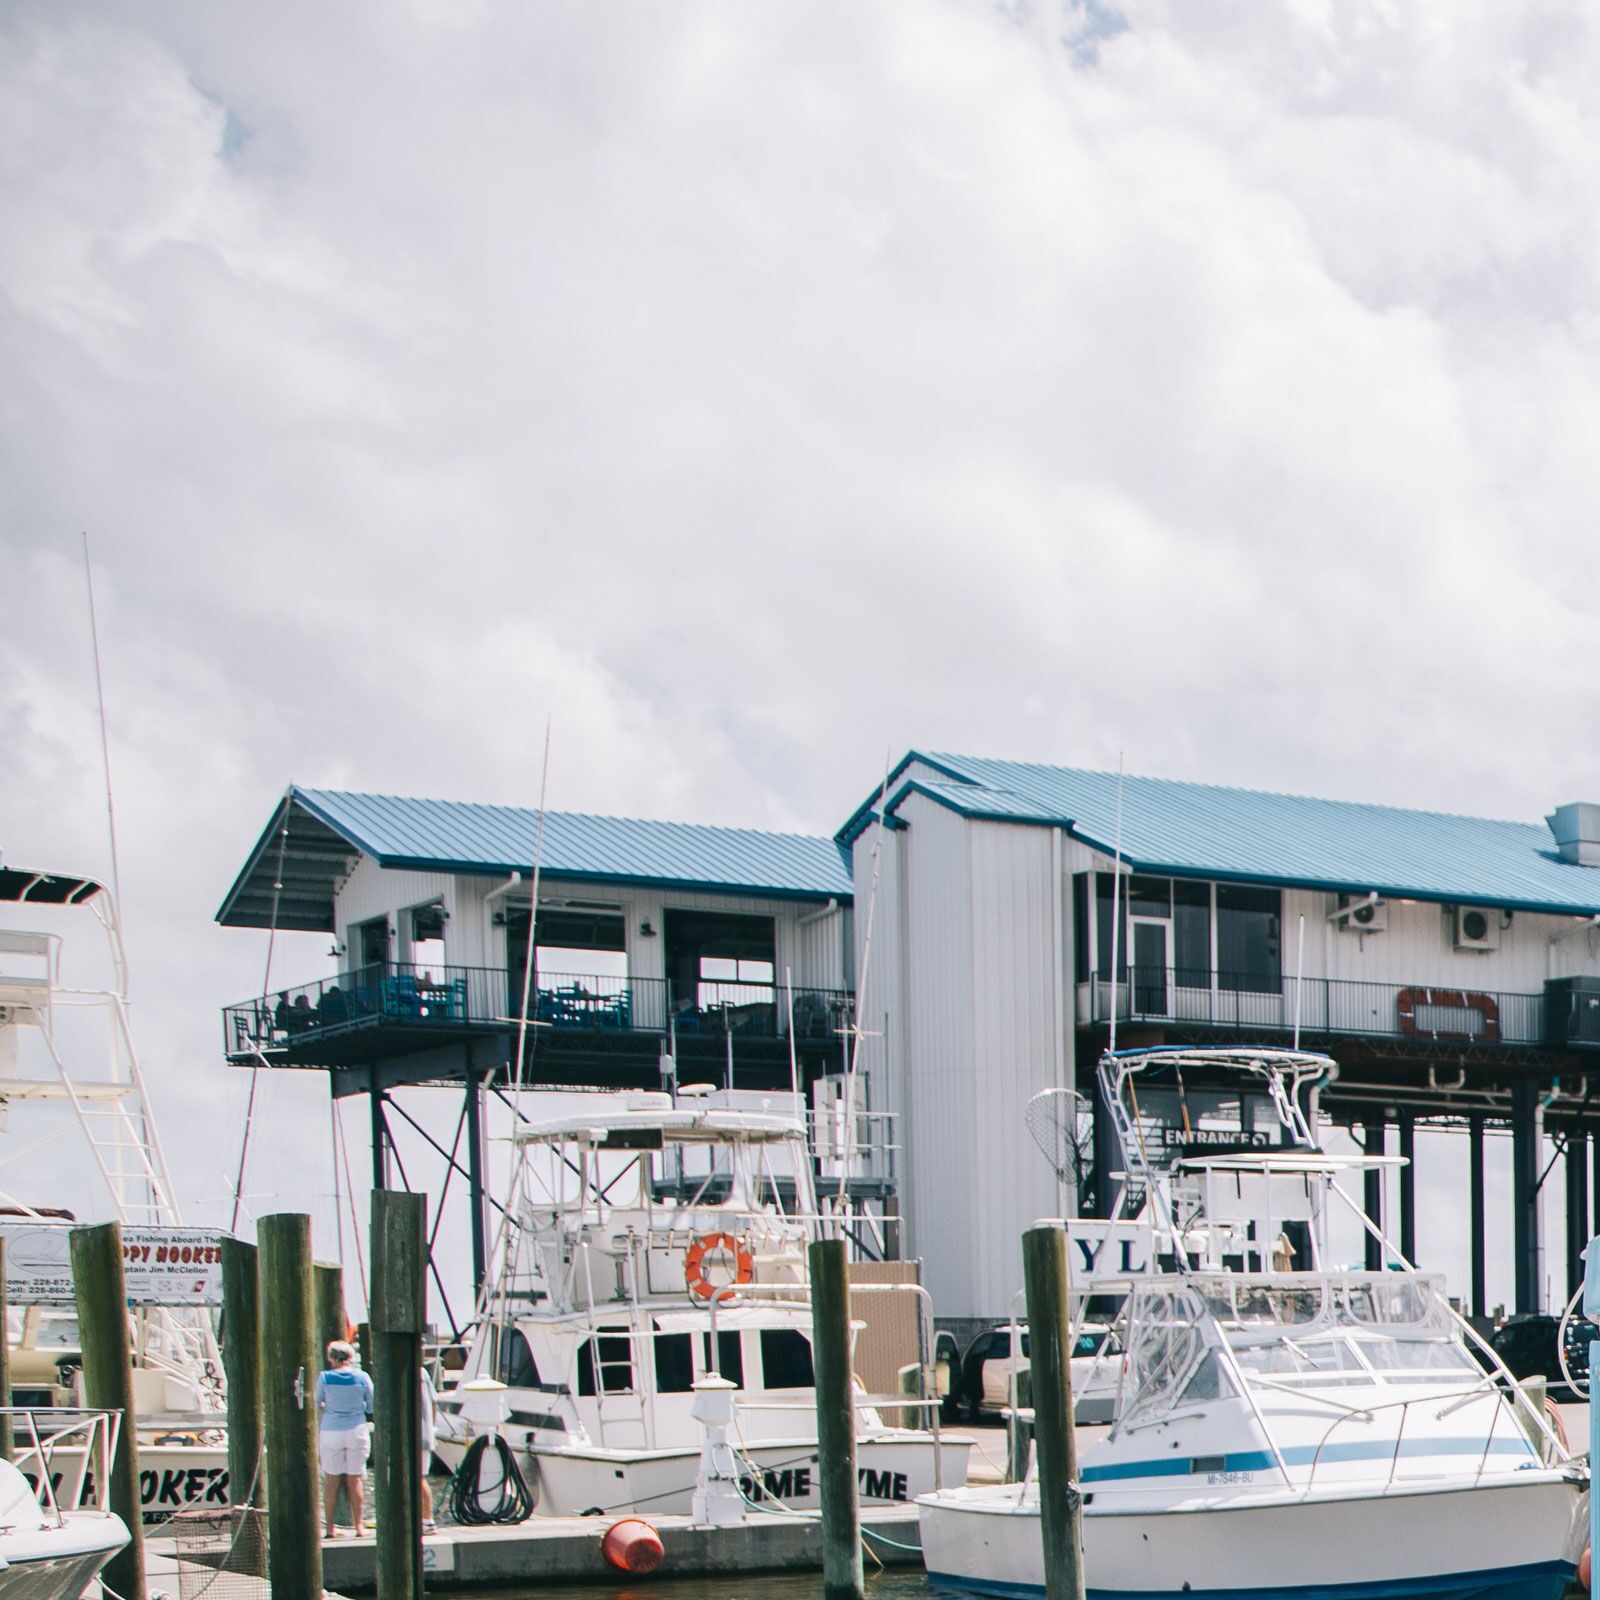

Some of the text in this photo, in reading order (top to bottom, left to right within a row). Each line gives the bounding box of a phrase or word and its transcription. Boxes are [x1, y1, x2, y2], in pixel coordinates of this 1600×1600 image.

[1165, 1130, 1249, 1145] ENTRANCE
[136, 1235, 169, 1245] Fishing
[170, 1235, 202, 1244] Aboard
[204, 1235, 222, 1244] The
[125, 1266, 147, 1274] ptain
[149, 1266, 165, 1274] Jim
